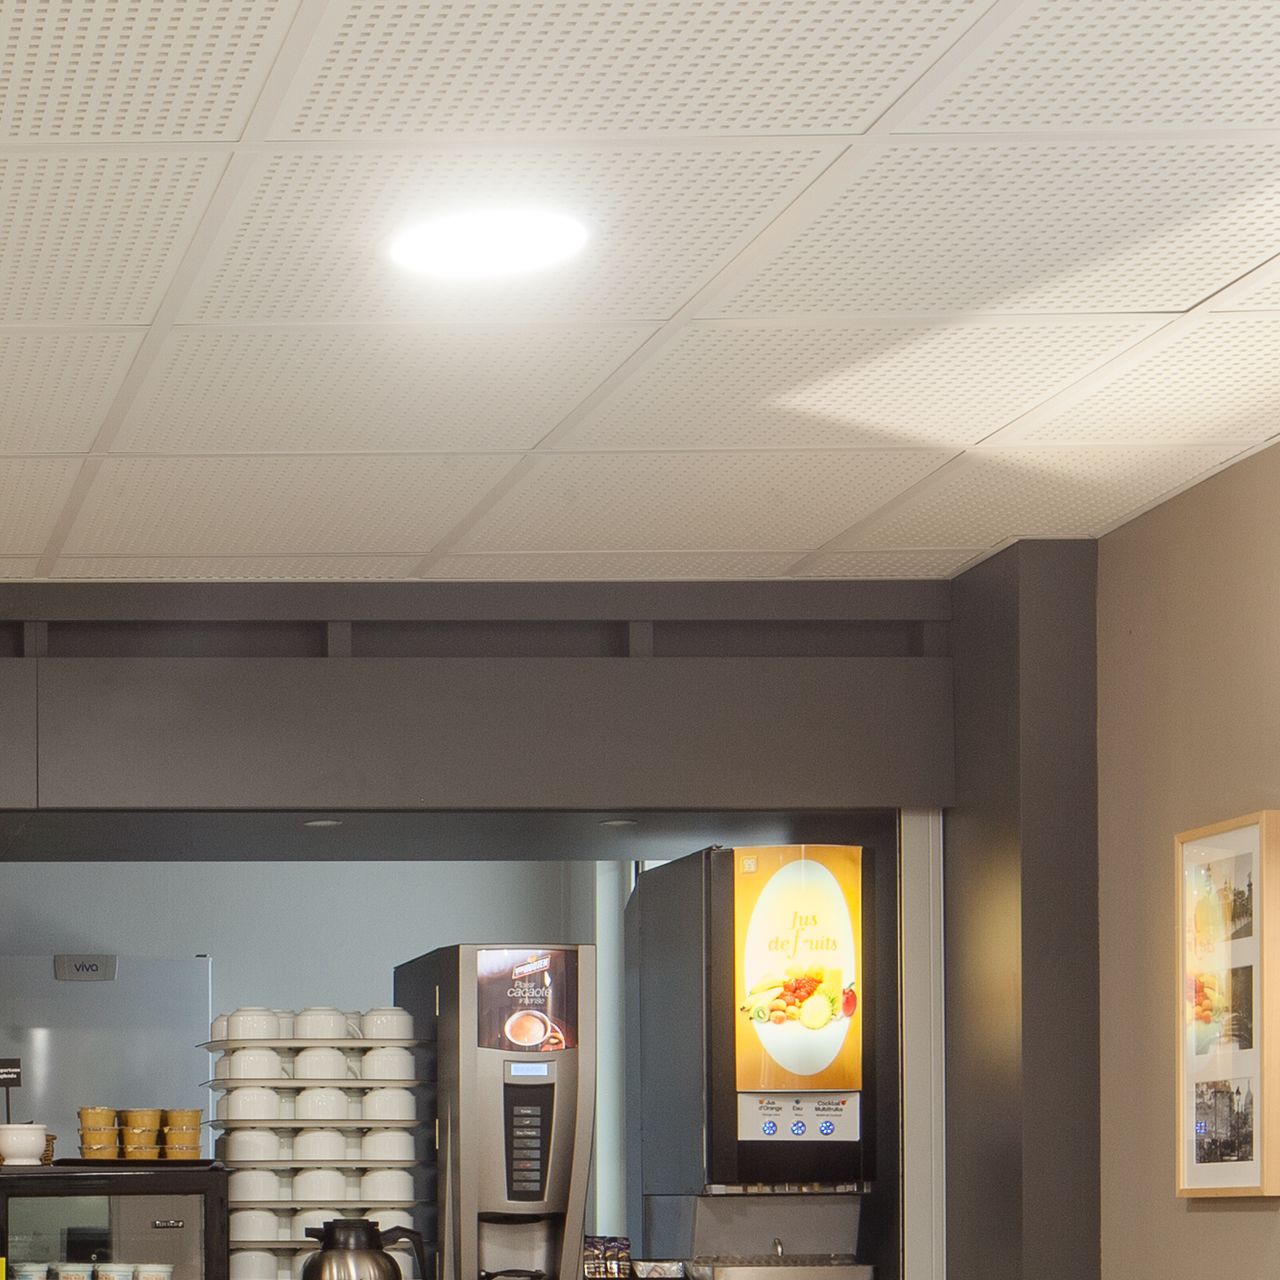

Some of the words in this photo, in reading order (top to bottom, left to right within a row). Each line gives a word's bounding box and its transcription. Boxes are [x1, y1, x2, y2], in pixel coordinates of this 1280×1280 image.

[790, 911, 817, 930] Jus
[768, 936, 790, 951] de
[74, 961, 99, 972] viva
